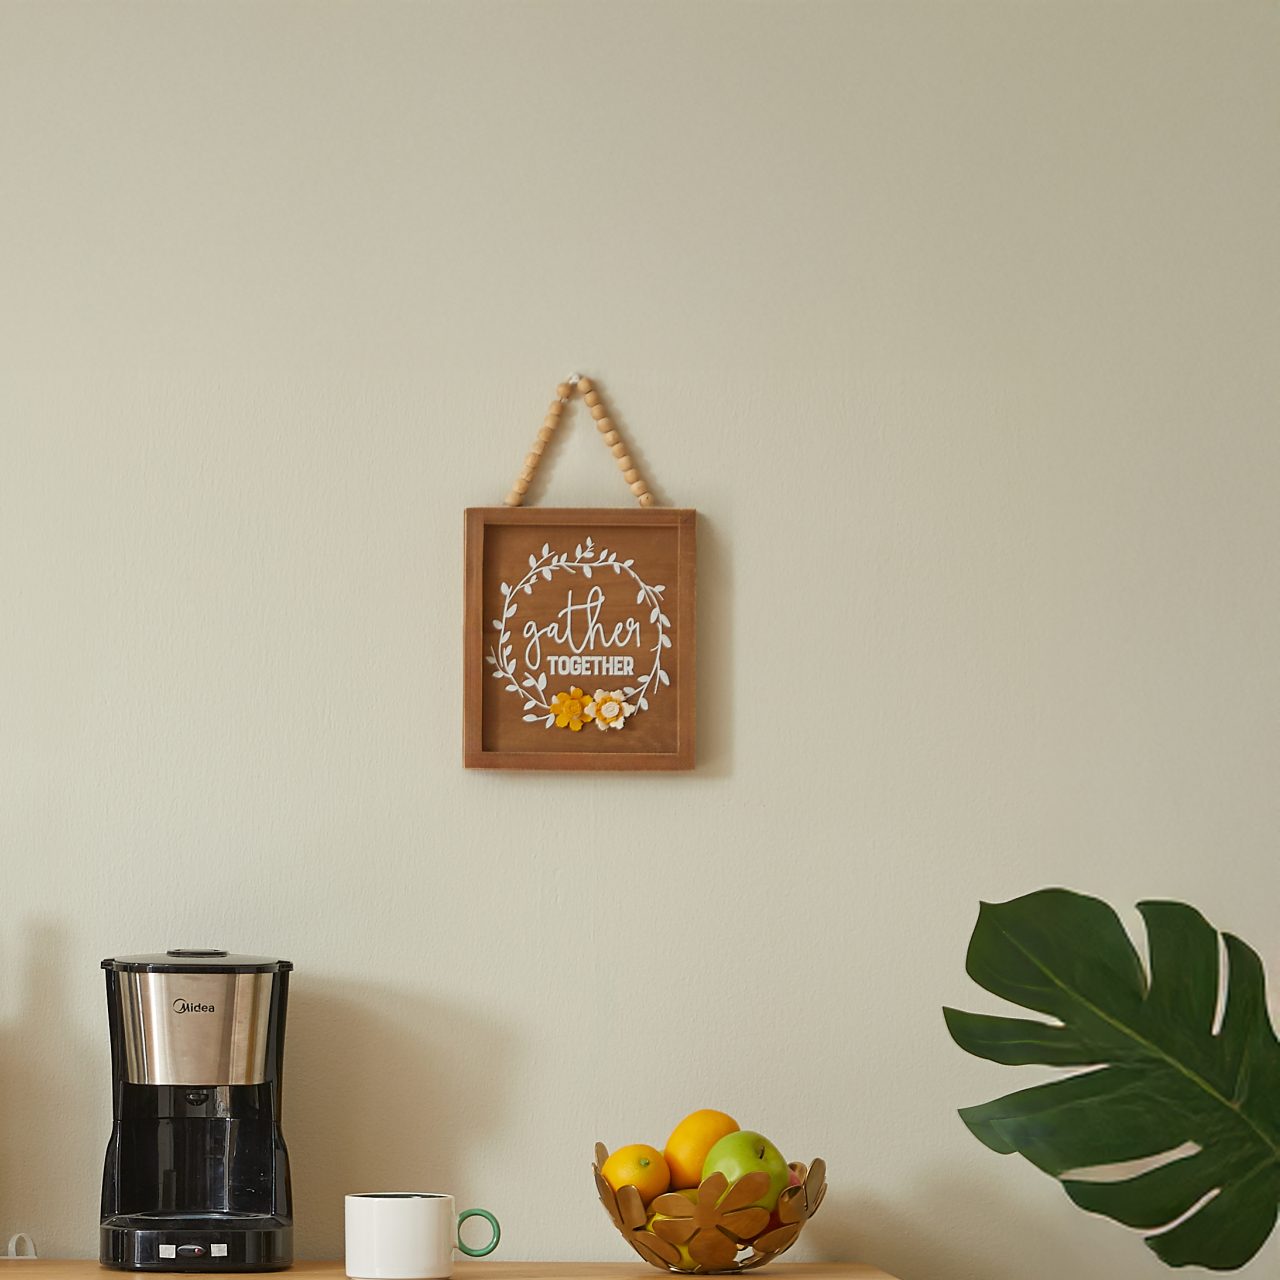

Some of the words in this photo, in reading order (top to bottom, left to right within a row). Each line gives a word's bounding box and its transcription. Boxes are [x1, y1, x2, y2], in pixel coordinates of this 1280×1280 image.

[522, 585, 641, 671] gather
[546, 655, 635, 676] TOGETHER
[173, 998, 215, 1014] Midea
